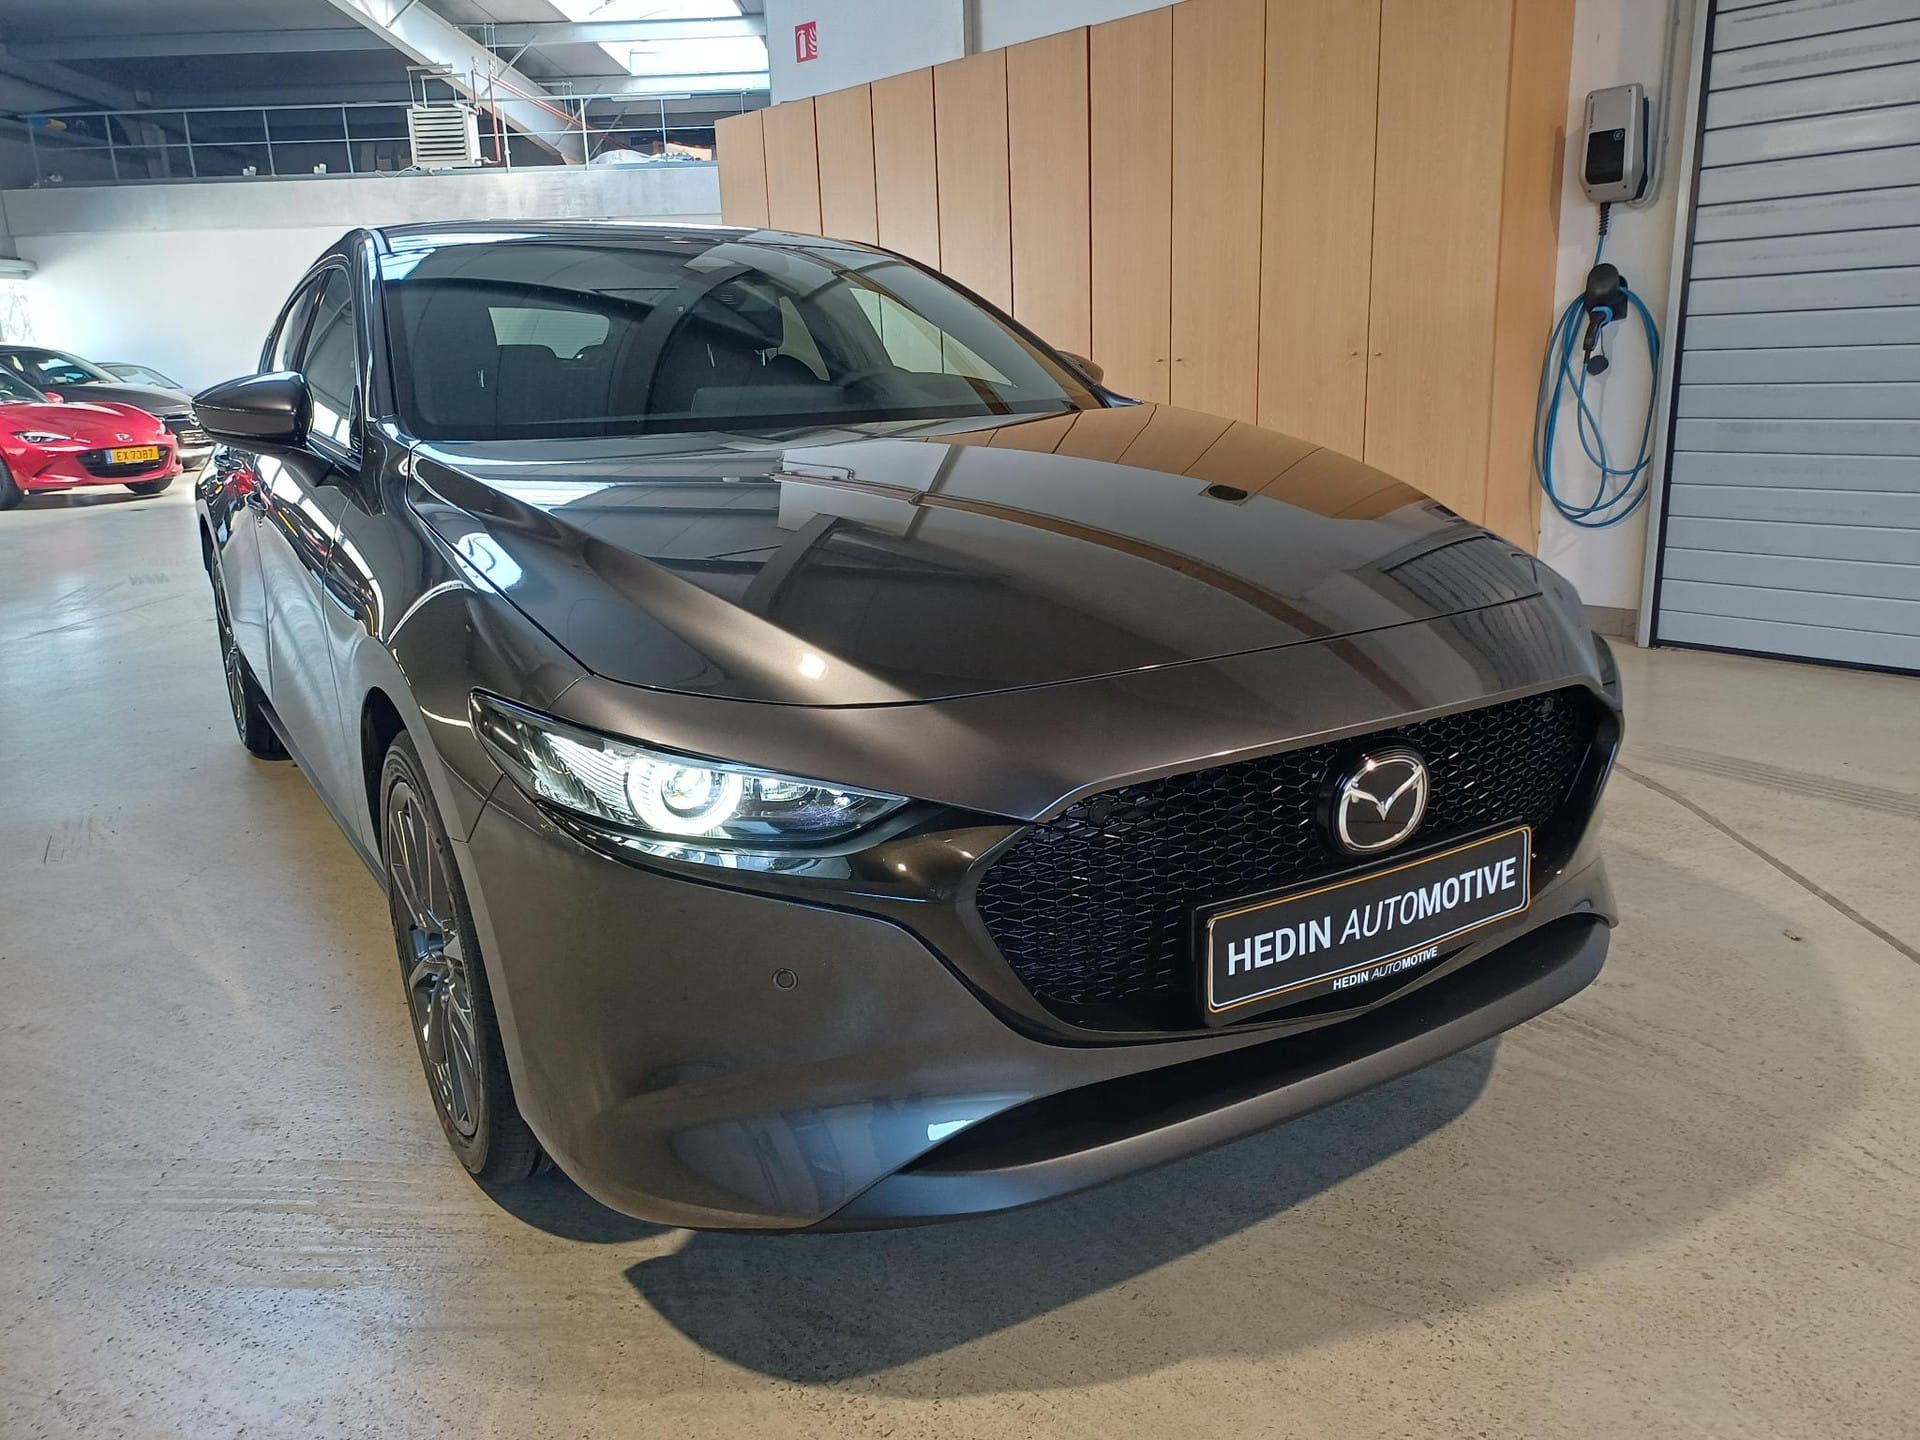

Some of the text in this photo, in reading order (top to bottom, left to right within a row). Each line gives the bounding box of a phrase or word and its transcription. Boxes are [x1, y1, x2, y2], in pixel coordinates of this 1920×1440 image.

[1228, 857, 1516, 976] HEDIN AUTOMOTIVE
[1333, 946, 1438, 990] HEDIN AUTOMOTIVE
